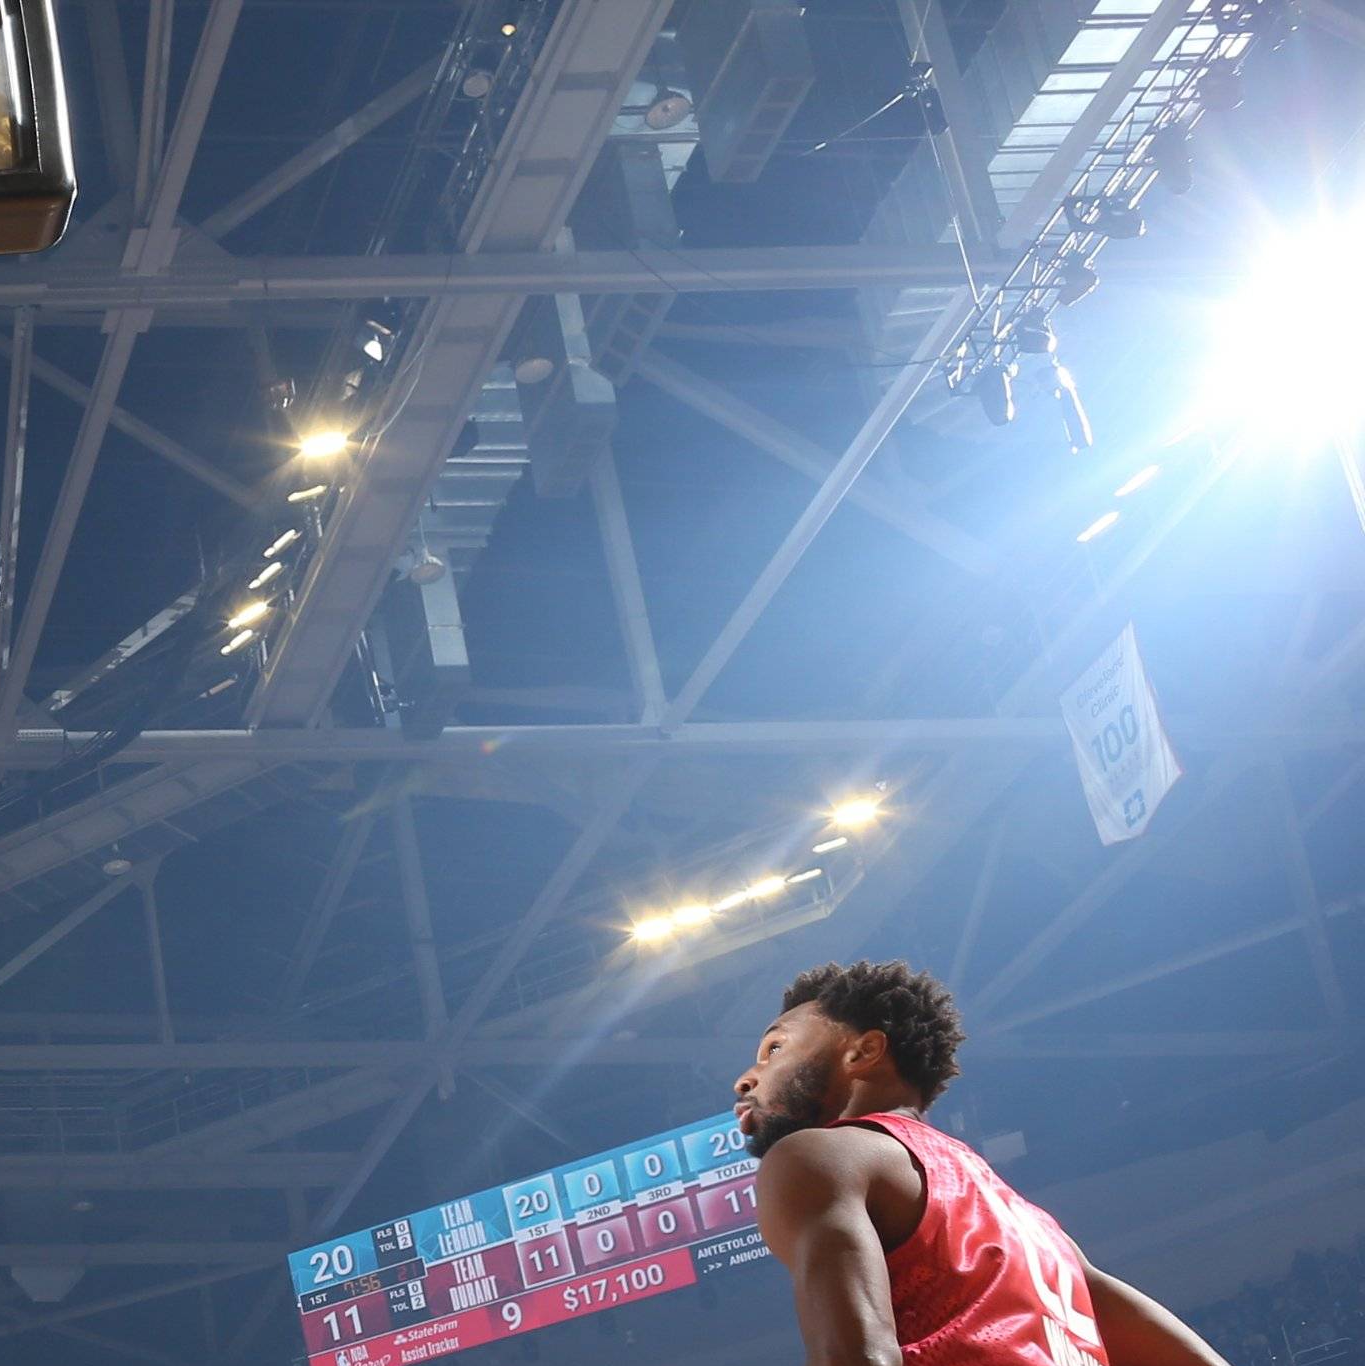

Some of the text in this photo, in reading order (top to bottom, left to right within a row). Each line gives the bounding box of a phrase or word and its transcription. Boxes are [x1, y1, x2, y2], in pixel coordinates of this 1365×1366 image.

[516, 1128, 746, 1218] 20 0 0 20
[439, 1199, 474, 1230] TEAM
[528, 1161, 756, 1238] 1ST 2ND 3RD TOTAL
[529, 1185, 758, 1273] 11 0 0 11
[309, 1245, 353, 1284] 20
[452, 1254, 486, 1284] TEAM
[308, 1293, 328, 1306] 1ST
[449, 1275, 499, 1312] DURANT
[563, 1264, 664, 1312] $17,100
[323, 1305, 363, 1341] 11
[502, 1302, 522, 1331] 9
[401, 1335, 460, 1364] Assist Tracker
